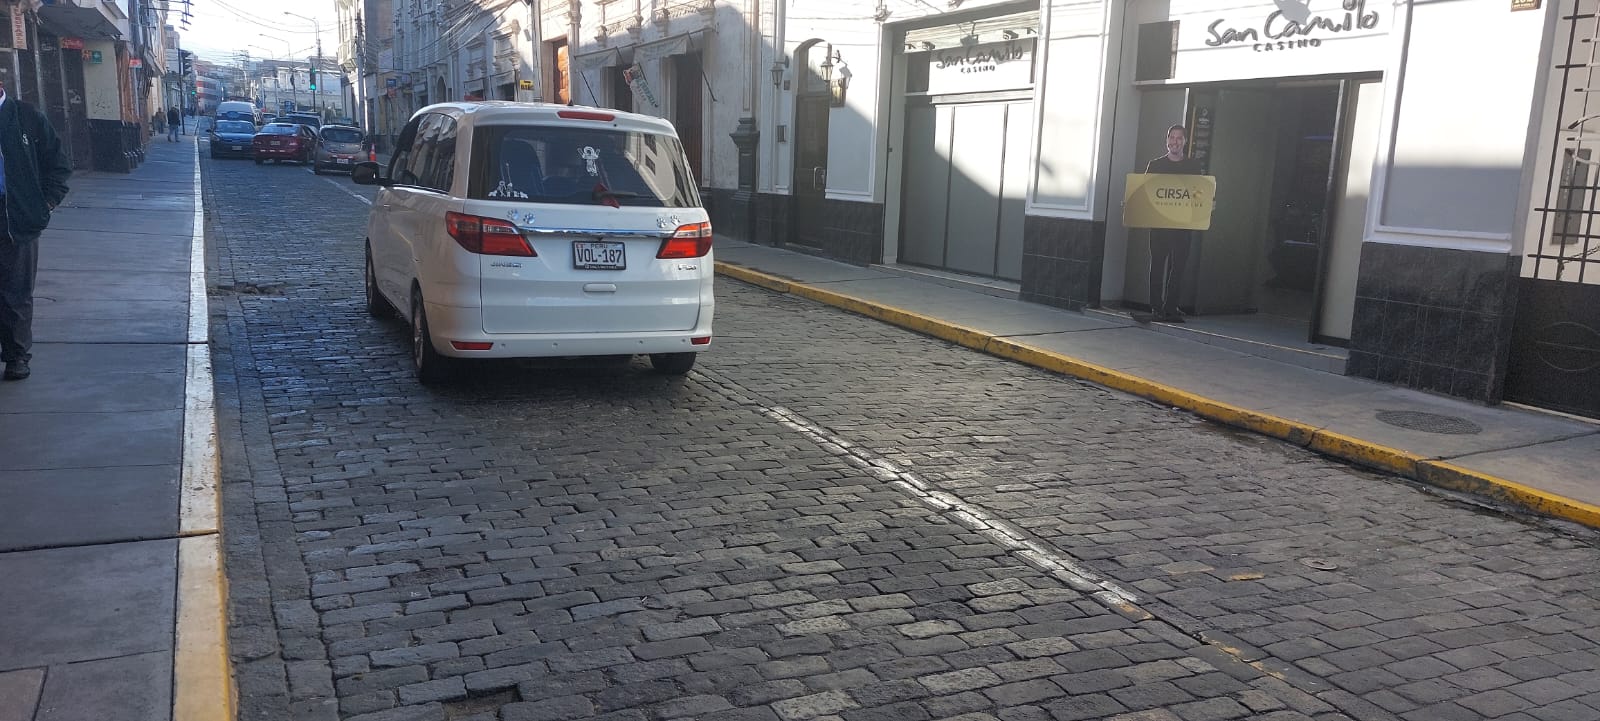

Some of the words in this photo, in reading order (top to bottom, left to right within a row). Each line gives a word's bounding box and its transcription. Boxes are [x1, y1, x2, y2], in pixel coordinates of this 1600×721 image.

[1205, 18, 1259, 47] San
[1253, 38, 1322, 53] CASINO
[936, 50, 964, 70] San
[1156, 187, 1191, 200] CIRSA
[576, 247, 622, 264] VOL-187
